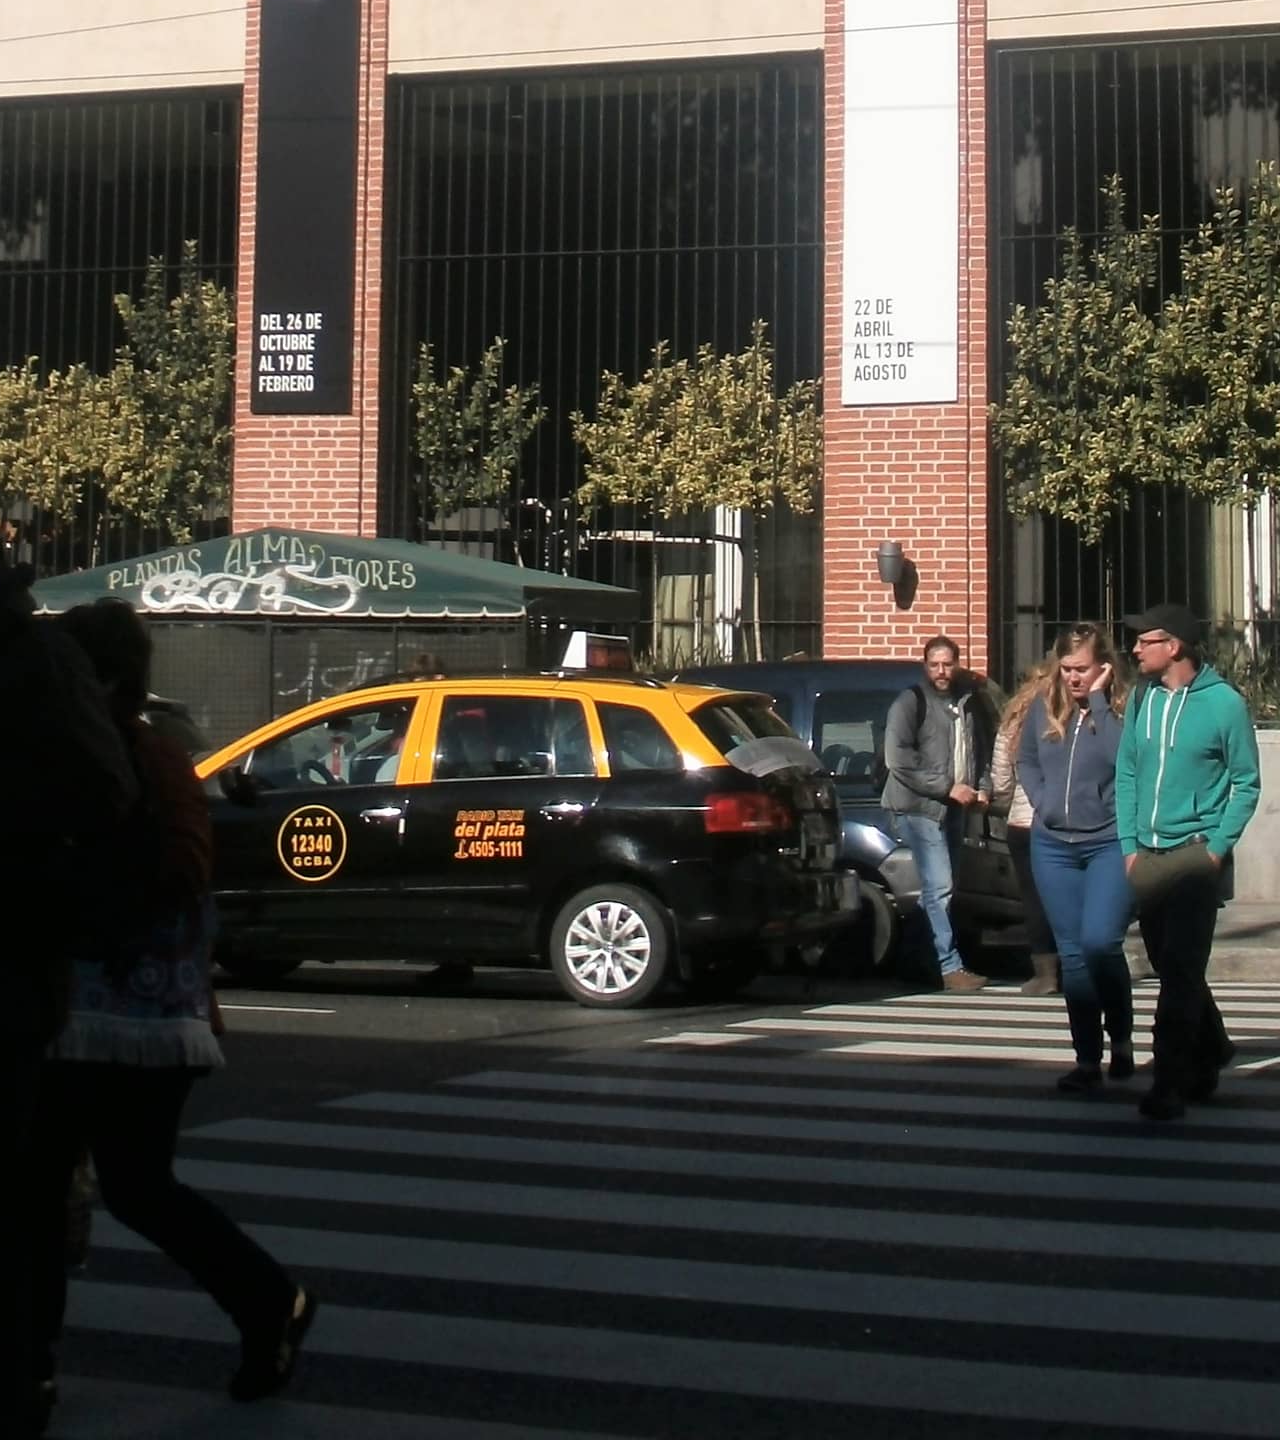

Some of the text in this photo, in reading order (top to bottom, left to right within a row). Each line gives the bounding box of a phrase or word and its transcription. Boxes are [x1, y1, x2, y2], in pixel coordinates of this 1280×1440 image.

[854, 298, 893, 316] 22 DE
[260, 313, 322, 331] DEL 26 DE
[854, 320, 894, 337] ABRIL
[259, 333, 316, 351] OCTUBRE
[854, 341, 914, 359] AL 13 DE
[259, 354, 314, 372] AL 19 DE
[854, 364, 907, 382] AGOSTO
[258, 375, 315, 393] FEBRERO
[108, 548, 203, 590] PLANTAS
[224, 534, 306, 576] ALMA
[294, 817, 332, 828] TAXI
[455, 822, 525, 840] del plata
[291, 834, 332, 853] 12340
[468, 841, 522, 857] 4505-1111
[293, 856, 333, 867] GCBA
